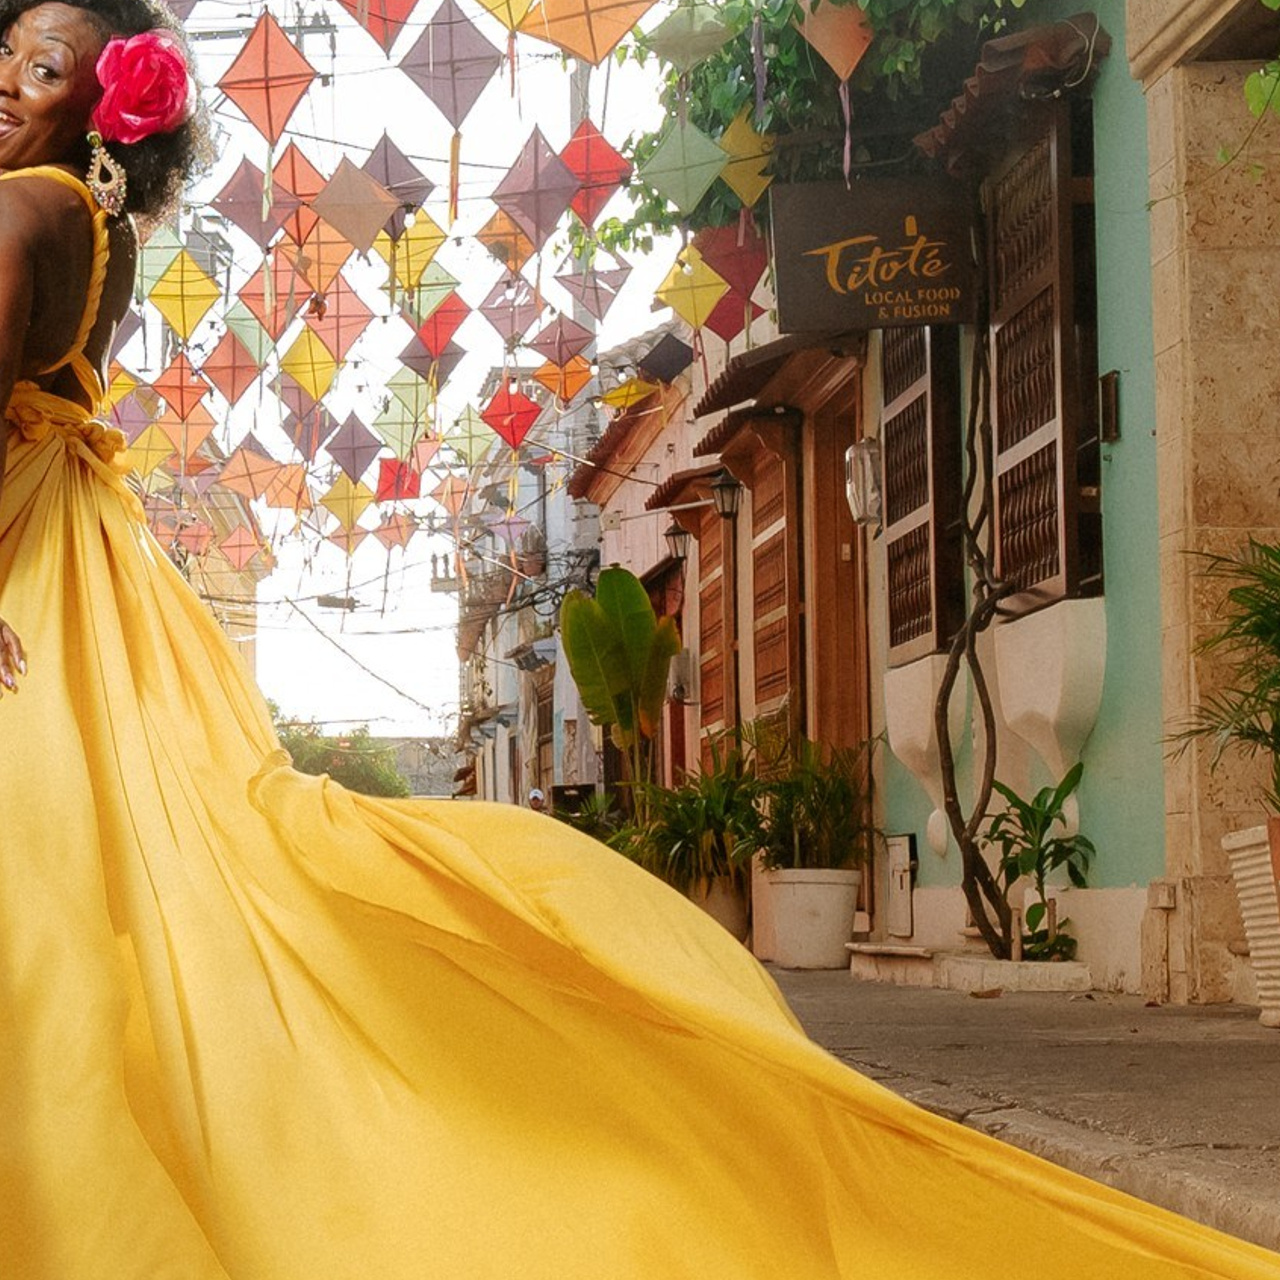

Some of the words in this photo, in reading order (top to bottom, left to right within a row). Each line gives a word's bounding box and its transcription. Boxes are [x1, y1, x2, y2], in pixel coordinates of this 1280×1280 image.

[801, 234, 952, 295] Titoté
[864, 290, 913, 305] LOCAL
[917, 287, 961, 300] FOOD
[878, 306, 889, 319] &
[893, 303, 950, 318] FUSION
